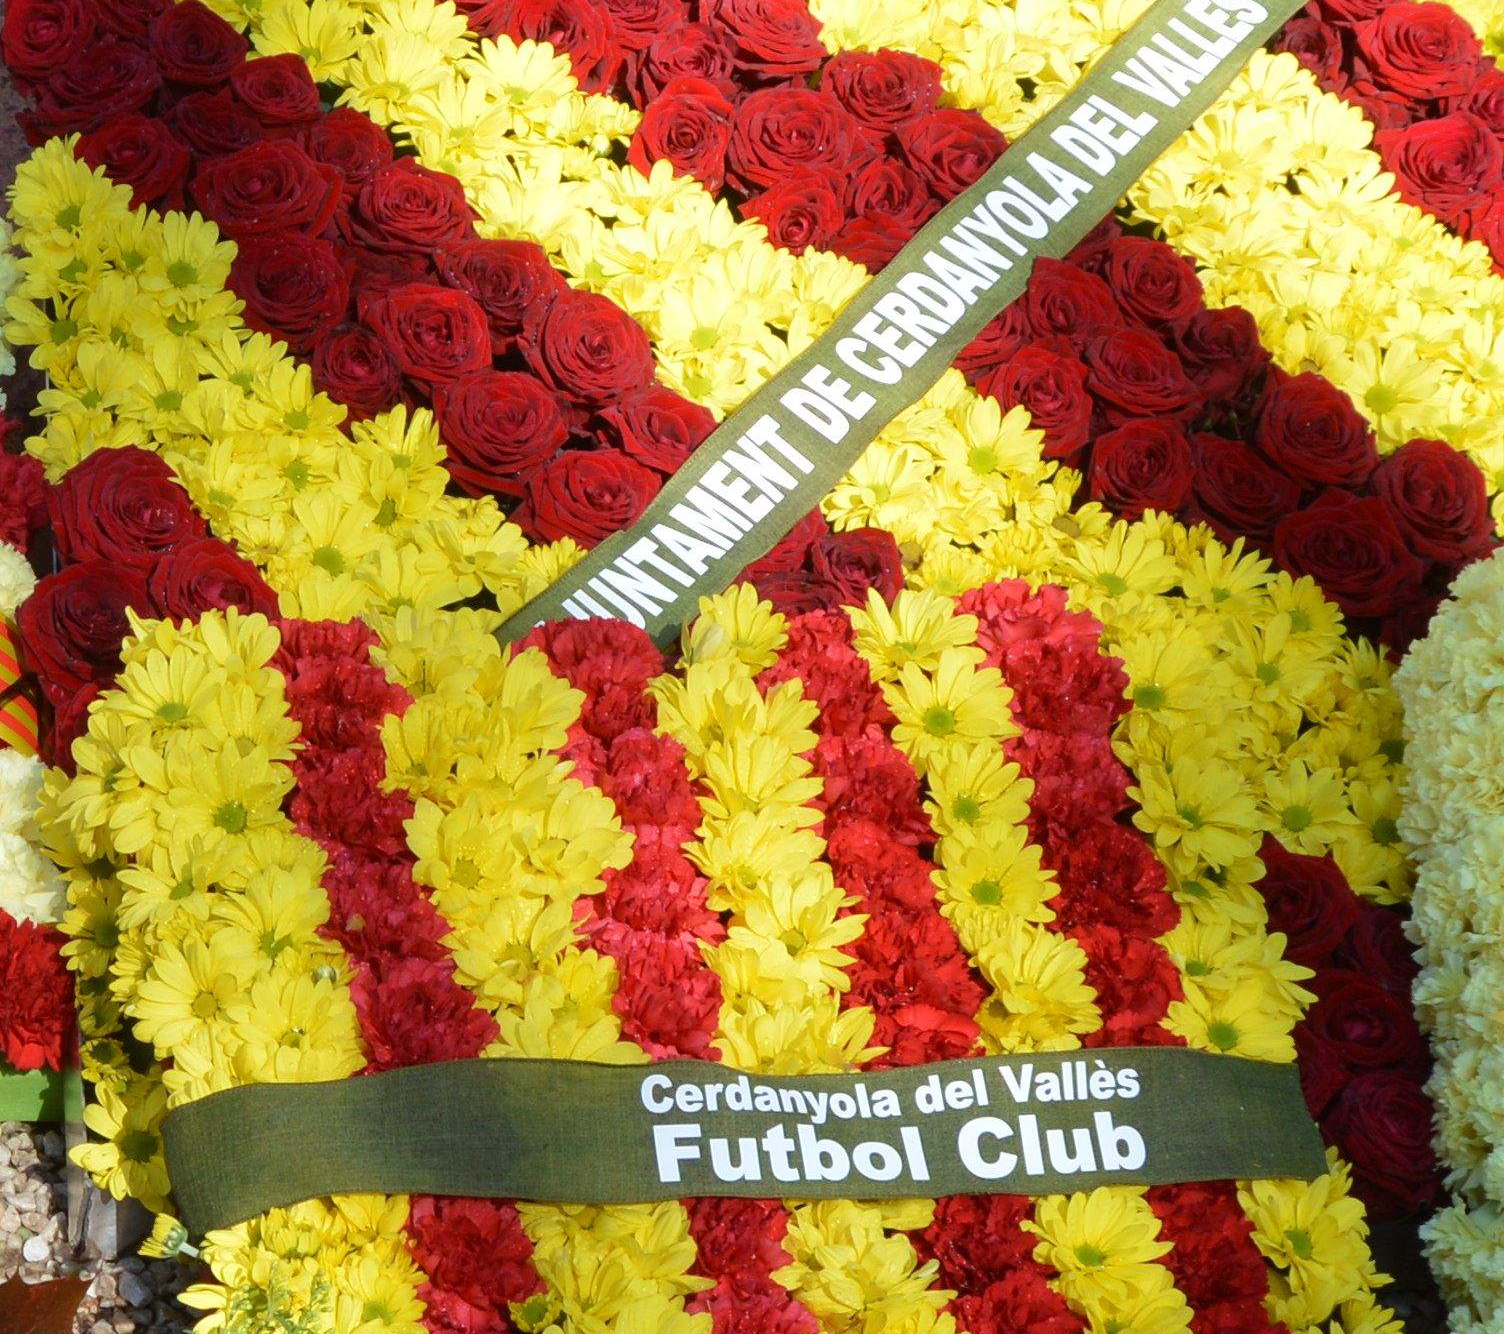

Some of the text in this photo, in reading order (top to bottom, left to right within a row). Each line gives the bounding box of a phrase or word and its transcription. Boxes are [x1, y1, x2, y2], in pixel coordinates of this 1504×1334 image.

[533, 414, 815, 629] UNTAMENT
[780, 364, 877, 444] DE
[835, 151, 1093, 385] CERDANYOLA
[1050, 94, 1158, 177] DEL
[640, 1058, 1142, 1125] Cerdanyola del Vallès
[652, 1110, 1148, 1184] Futbol Club
